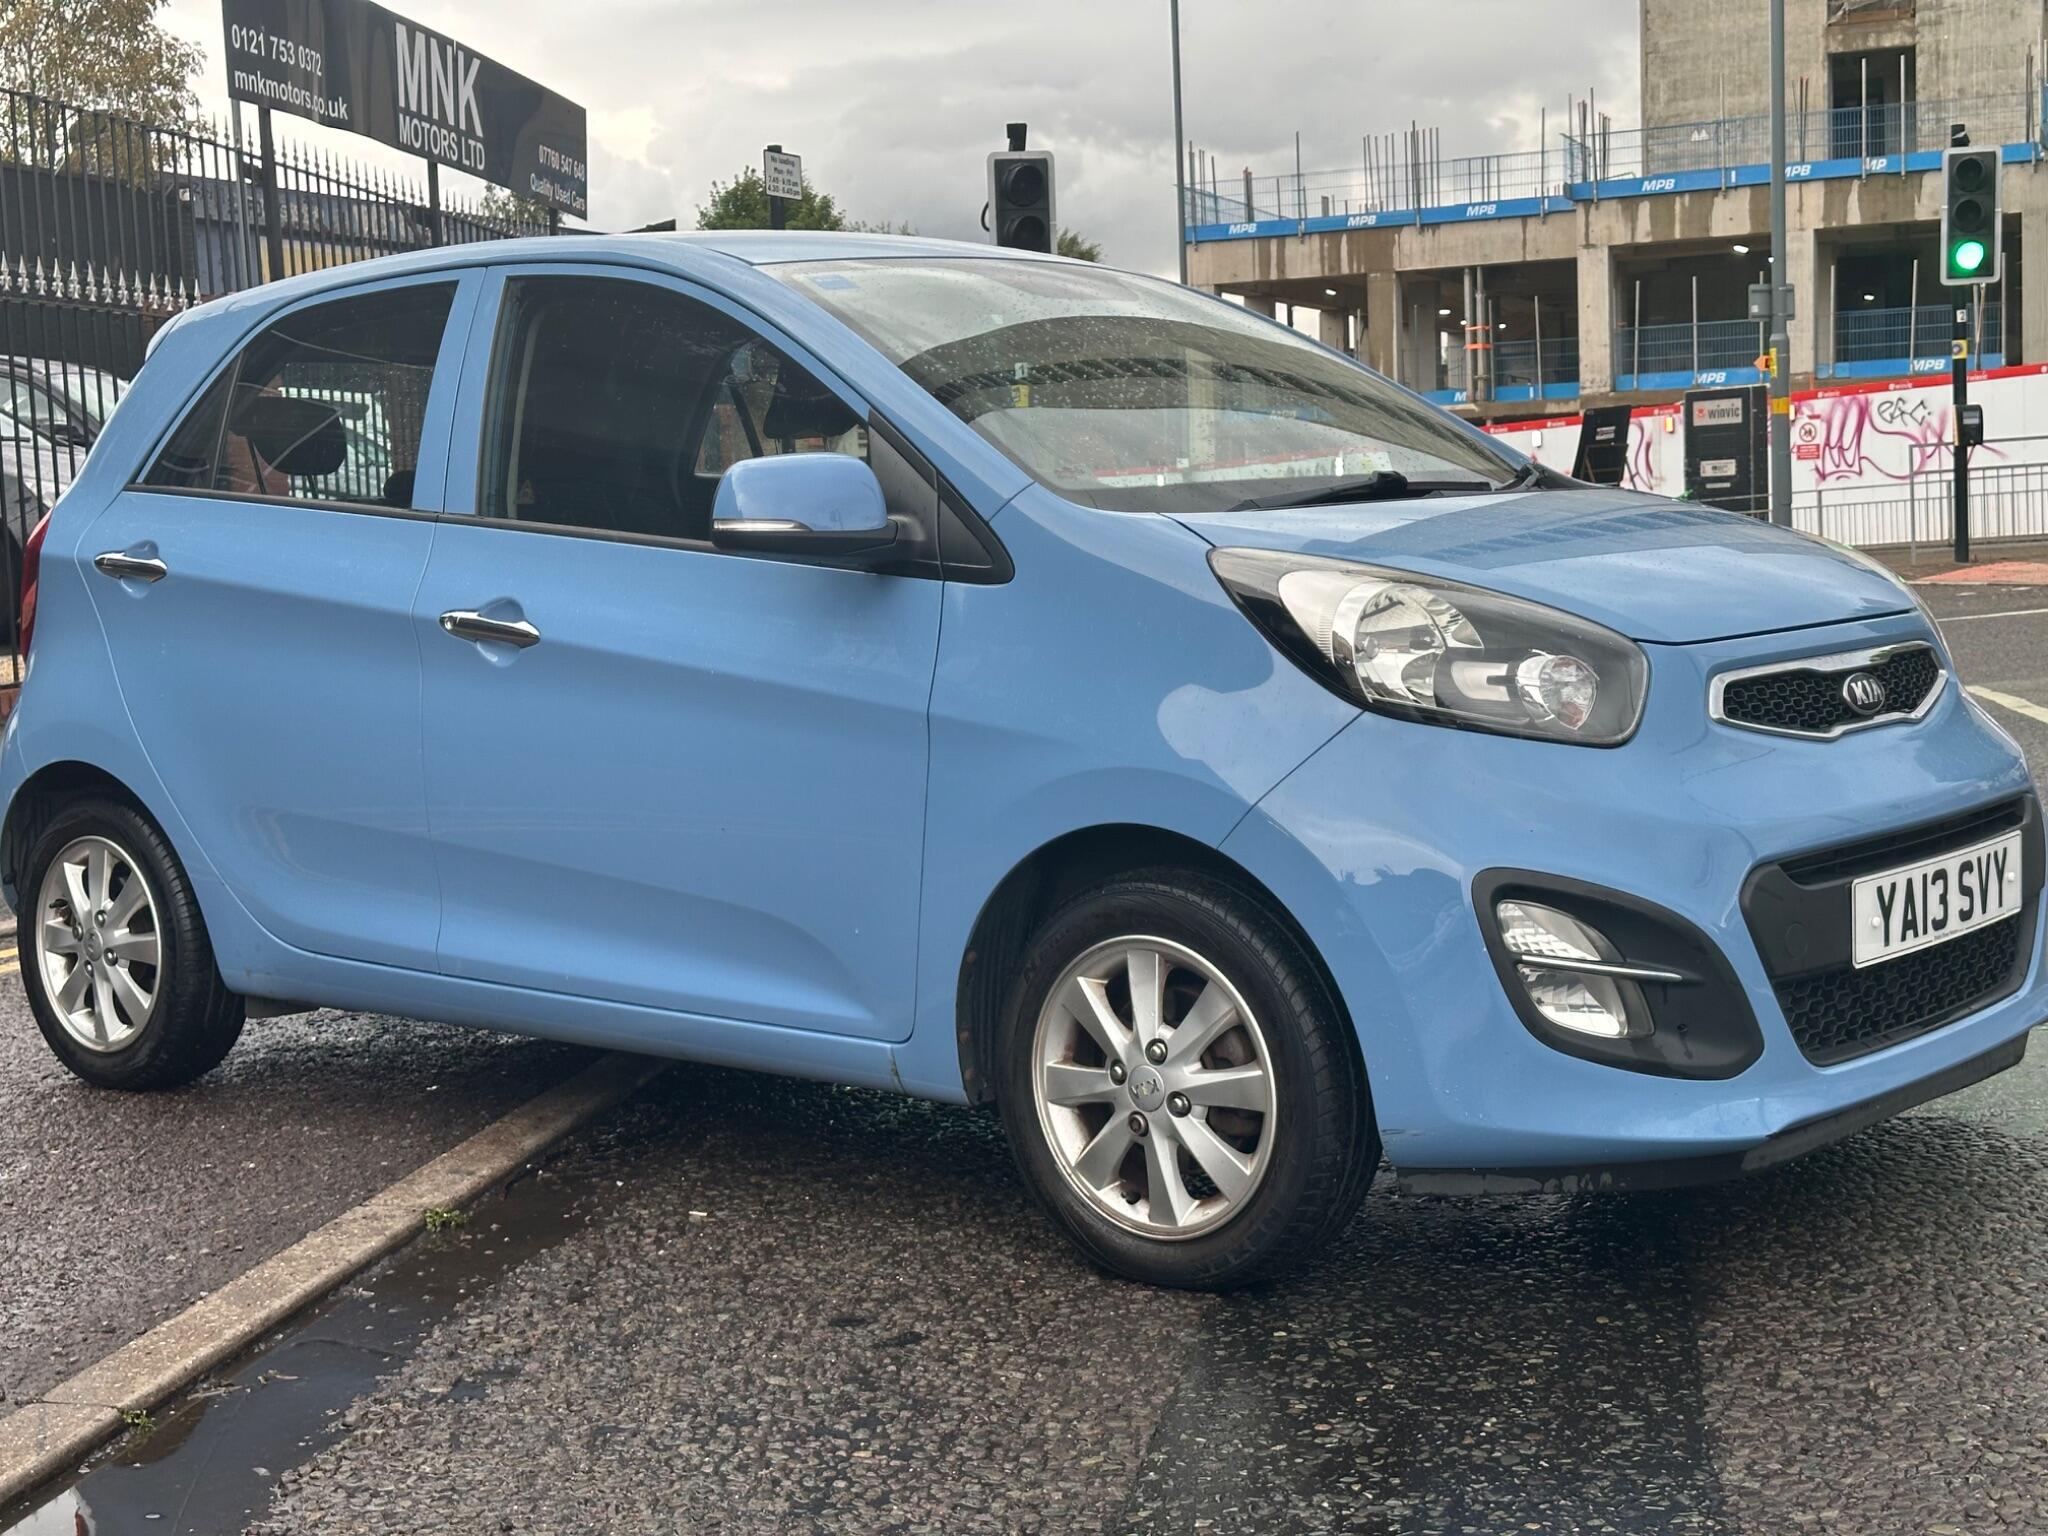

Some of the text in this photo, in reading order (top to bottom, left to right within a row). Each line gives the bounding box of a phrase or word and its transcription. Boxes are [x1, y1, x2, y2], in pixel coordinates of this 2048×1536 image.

[232, 24, 322, 76] 0121 753 0372
[396, 22, 483, 138] MNK
[234, 70, 348, 120] mnkmotors.co.uk
[399, 113, 485, 170] MOTORS LTD
[1865, 157, 1888, 171] MP
[1641, 178, 1676, 192] MPB
[554, 183, 570, 205] Used
[1466, 204, 1497, 217] MPB
[1228, 222, 1257, 235] MPB
[1347, 214, 1377, 227] MPB
[1912, 358, 1946, 372] MPB
[1697, 371, 1726, 384] MPB
[1707, 403, 1741, 420] winvic
[1850, 679, 1883, 705] KIA
[1876, 846, 2008, 948] YA13 SVY
